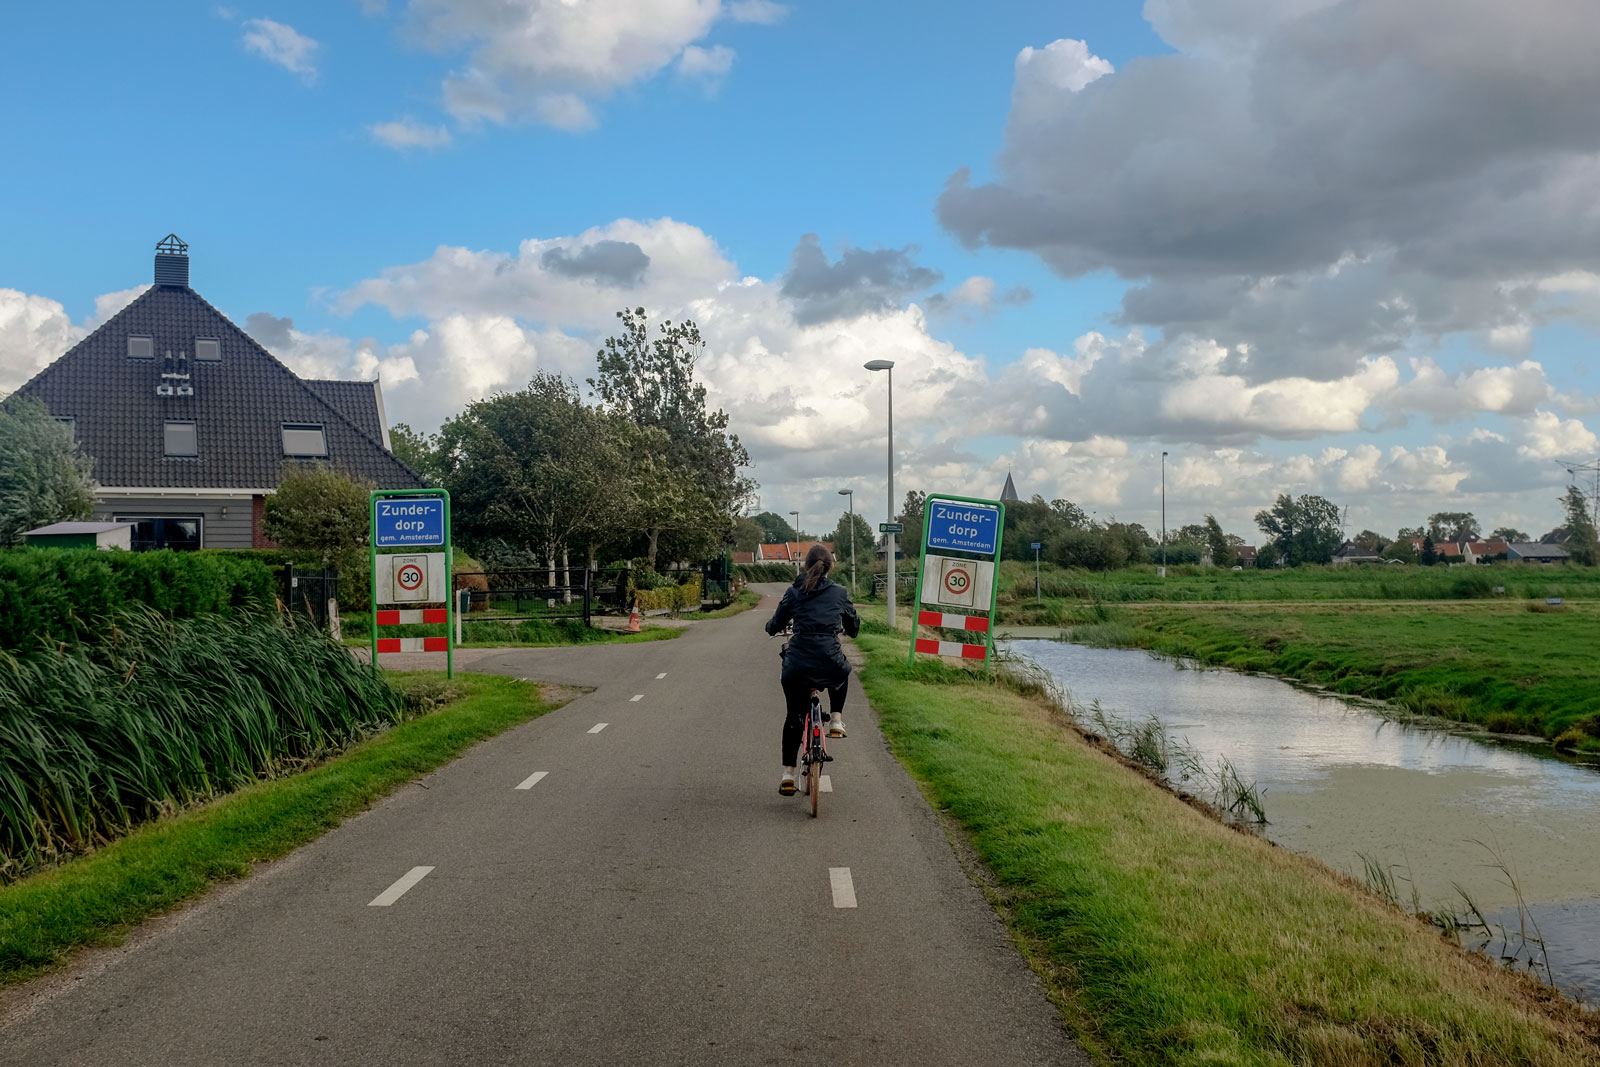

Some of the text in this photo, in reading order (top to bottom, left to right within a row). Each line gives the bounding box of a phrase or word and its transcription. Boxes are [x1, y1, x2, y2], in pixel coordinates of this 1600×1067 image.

[381, 504, 436, 516] Zunder-
[936, 507, 991, 523] Zunder-
[395, 519, 425, 532] dorp
[948, 524, 978, 539] dorp
[380, 535, 397, 543] gem.
[951, 539, 991, 549] Amsterdam
[402, 572, 419, 582] 30
[949, 575, 966, 587] 30
